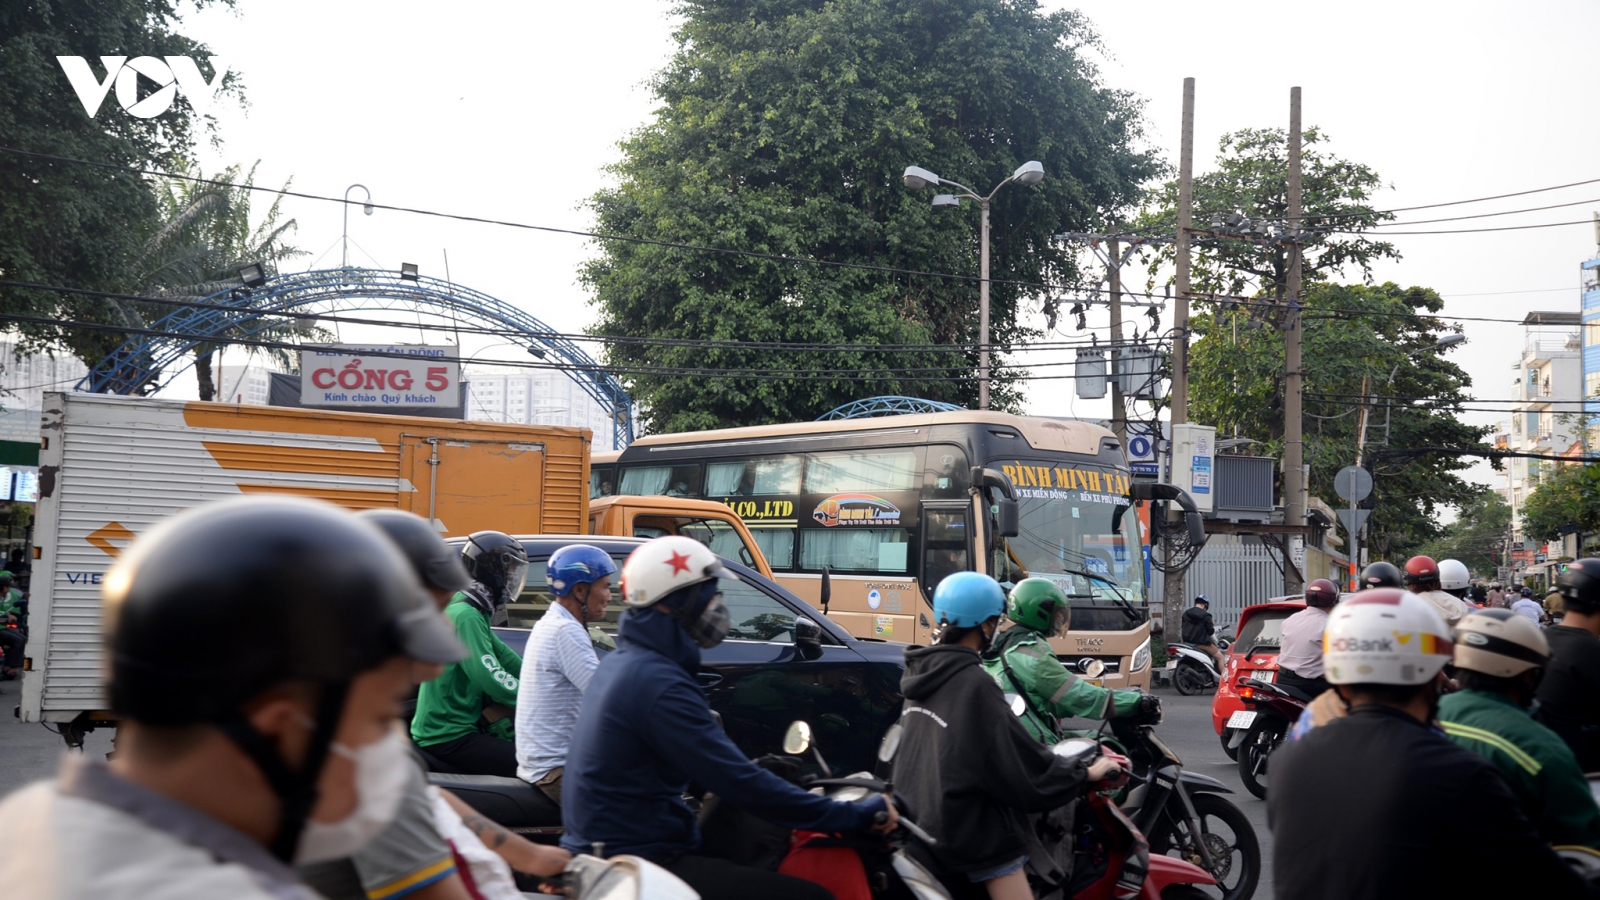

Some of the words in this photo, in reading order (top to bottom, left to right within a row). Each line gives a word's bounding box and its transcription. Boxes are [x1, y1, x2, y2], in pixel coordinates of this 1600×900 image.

[311, 358, 414, 391] CỔNG
[425, 366, 449, 391] 5
[324, 392, 348, 402] Kính
[351, 393, 377, 402] chào
[381, 393, 401, 404] Quý
[405, 394, 436, 403] khách
[1002, 460, 1052, 488] BÌNH
[1054, 467, 1102, 492] MINH
[1103, 469, 1131, 496] TẢI
[481, 654, 518, 690] Grab
